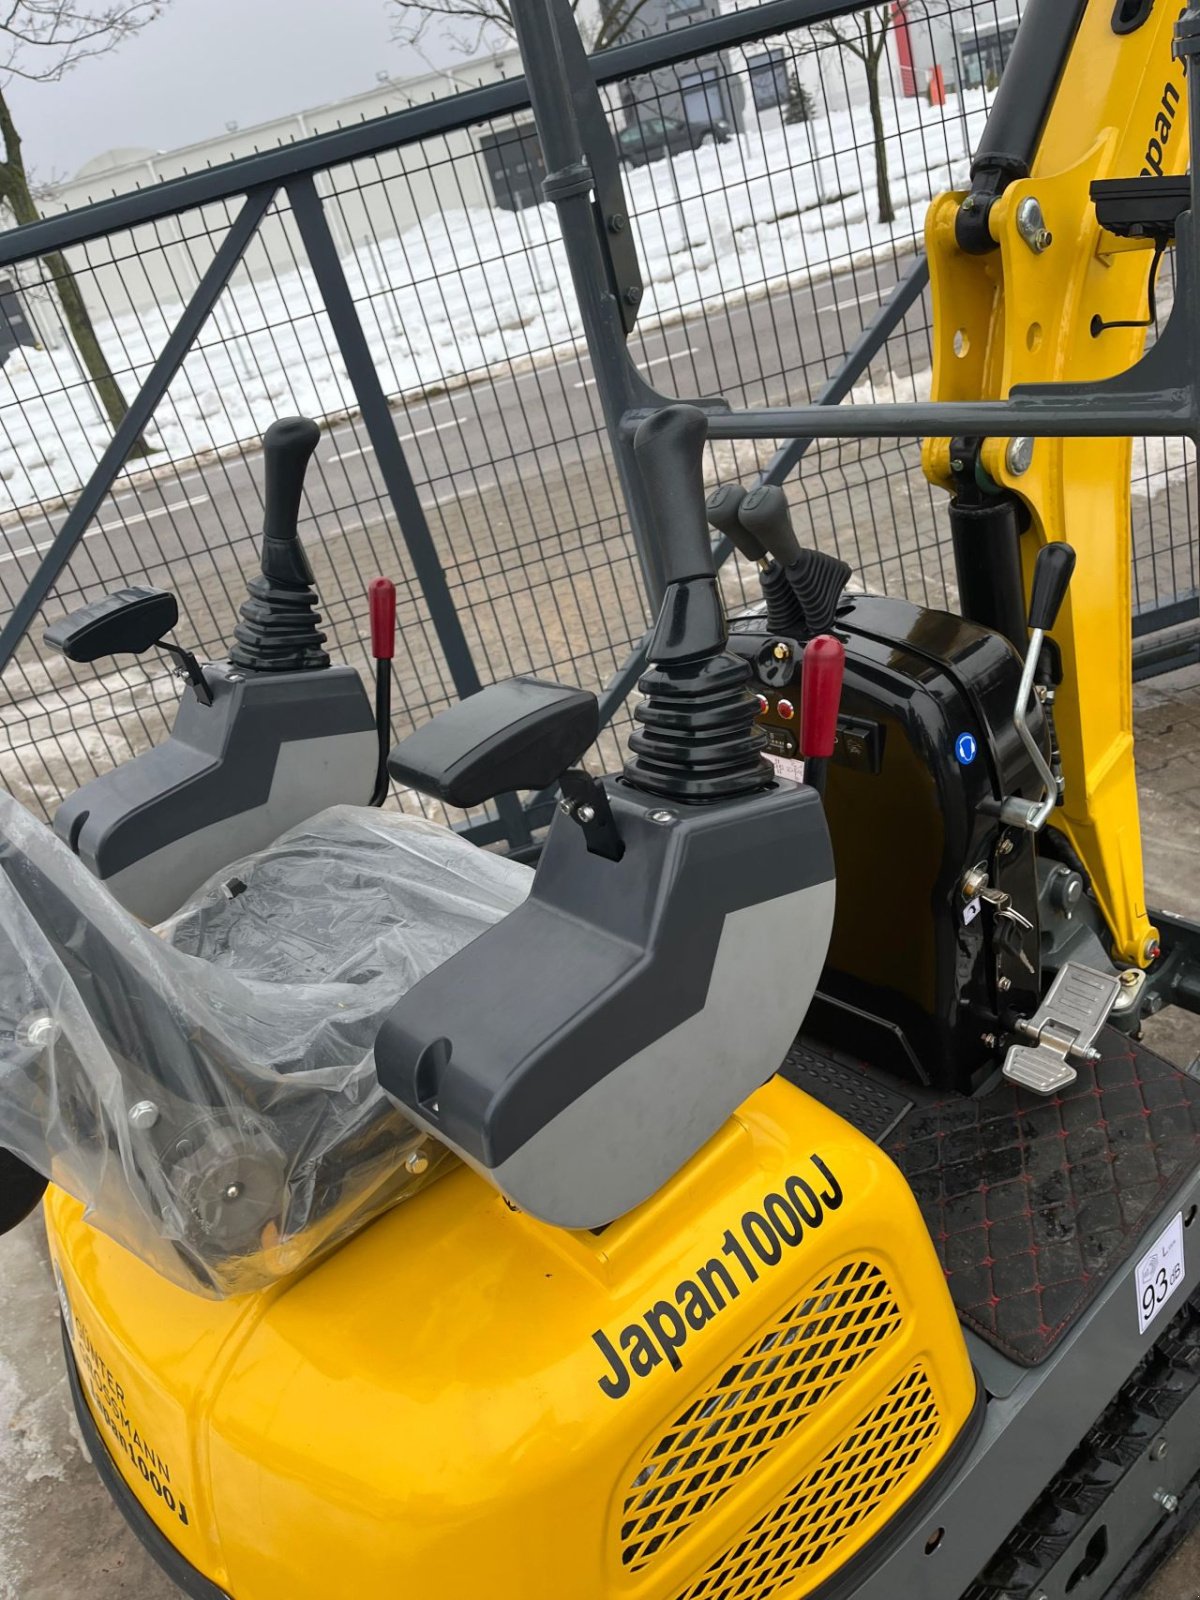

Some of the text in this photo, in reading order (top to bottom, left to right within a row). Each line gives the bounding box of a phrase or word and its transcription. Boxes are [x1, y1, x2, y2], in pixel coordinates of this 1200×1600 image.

[591, 1153, 843, 1400] Japan1000J
[1142, 1262, 1181, 1320] 93 dB
[79, 1341, 170, 1483] GROSSMANN
[89, 1378, 189, 1526] Japan1000J
